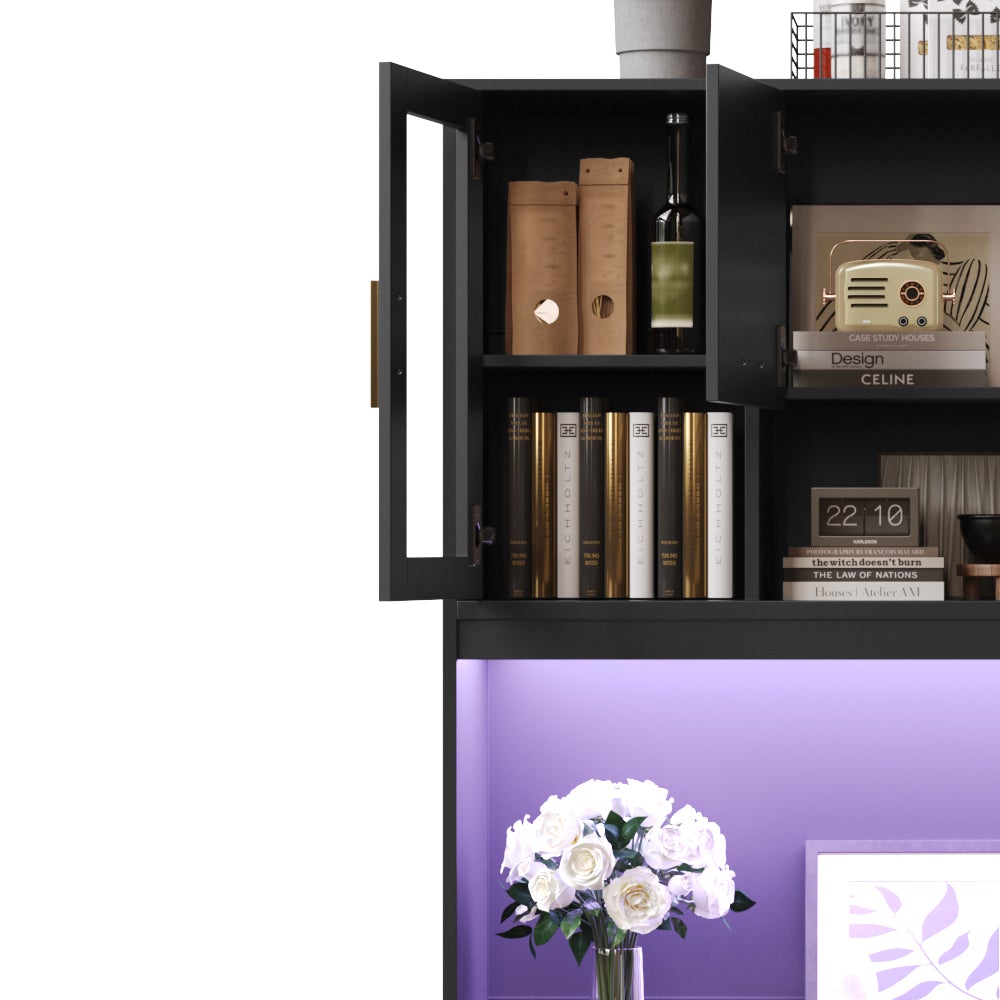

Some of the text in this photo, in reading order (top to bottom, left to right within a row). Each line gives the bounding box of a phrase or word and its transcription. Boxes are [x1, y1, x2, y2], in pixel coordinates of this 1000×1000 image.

[849, 334, 935, 342] CASE STUDY HOUSES
[831, 352, 884, 369] Design
[861, 373, 915, 386] CELINE
[826, 503, 903, 527] 22 10
[812, 558, 922, 567] the witch doesn't burn
[813, 571, 918, 579] THE LAW OF NATIONS
[815, 586, 921, 598] Houses Atelier AM
